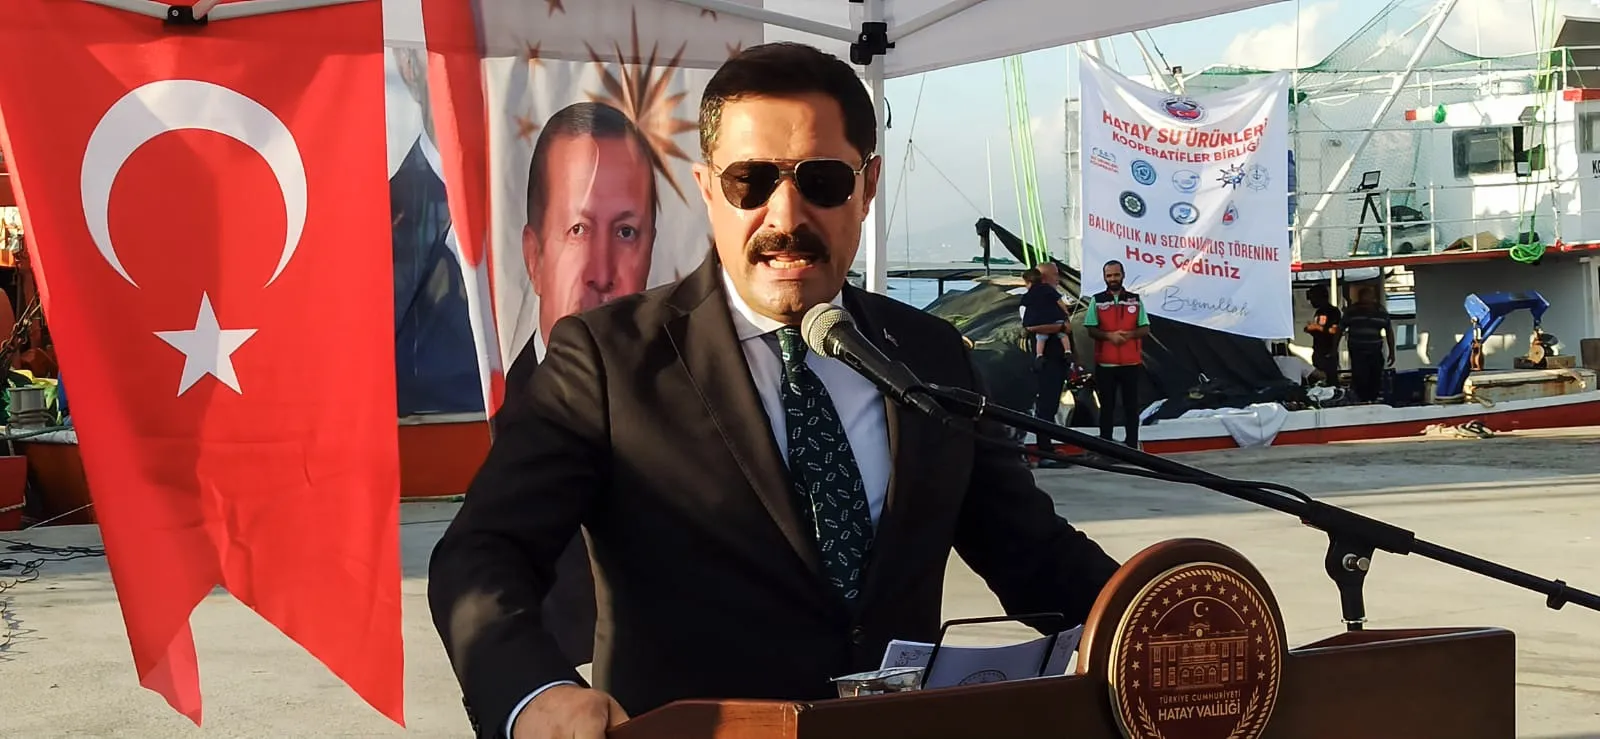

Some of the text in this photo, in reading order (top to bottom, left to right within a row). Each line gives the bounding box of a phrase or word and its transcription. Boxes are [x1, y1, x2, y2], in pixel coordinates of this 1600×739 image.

[1102, 110, 1269, 148] HATAY SU ÜRÜNLERİ
[1112, 131, 1211, 162] KOOPERATİFLER
[1088, 213, 1141, 242] BALIKÇILIK
[1144, 231, 1157, 246] AV
[1228, 240, 1280, 262] TÖRENİNE
[1126, 245, 1166, 268] Hoş
[1158, 698, 1241, 721] HATAY VALİLİĞİ
[1160, 689, 1241, 704] TÜRKİYE CUMHURİYETİ
